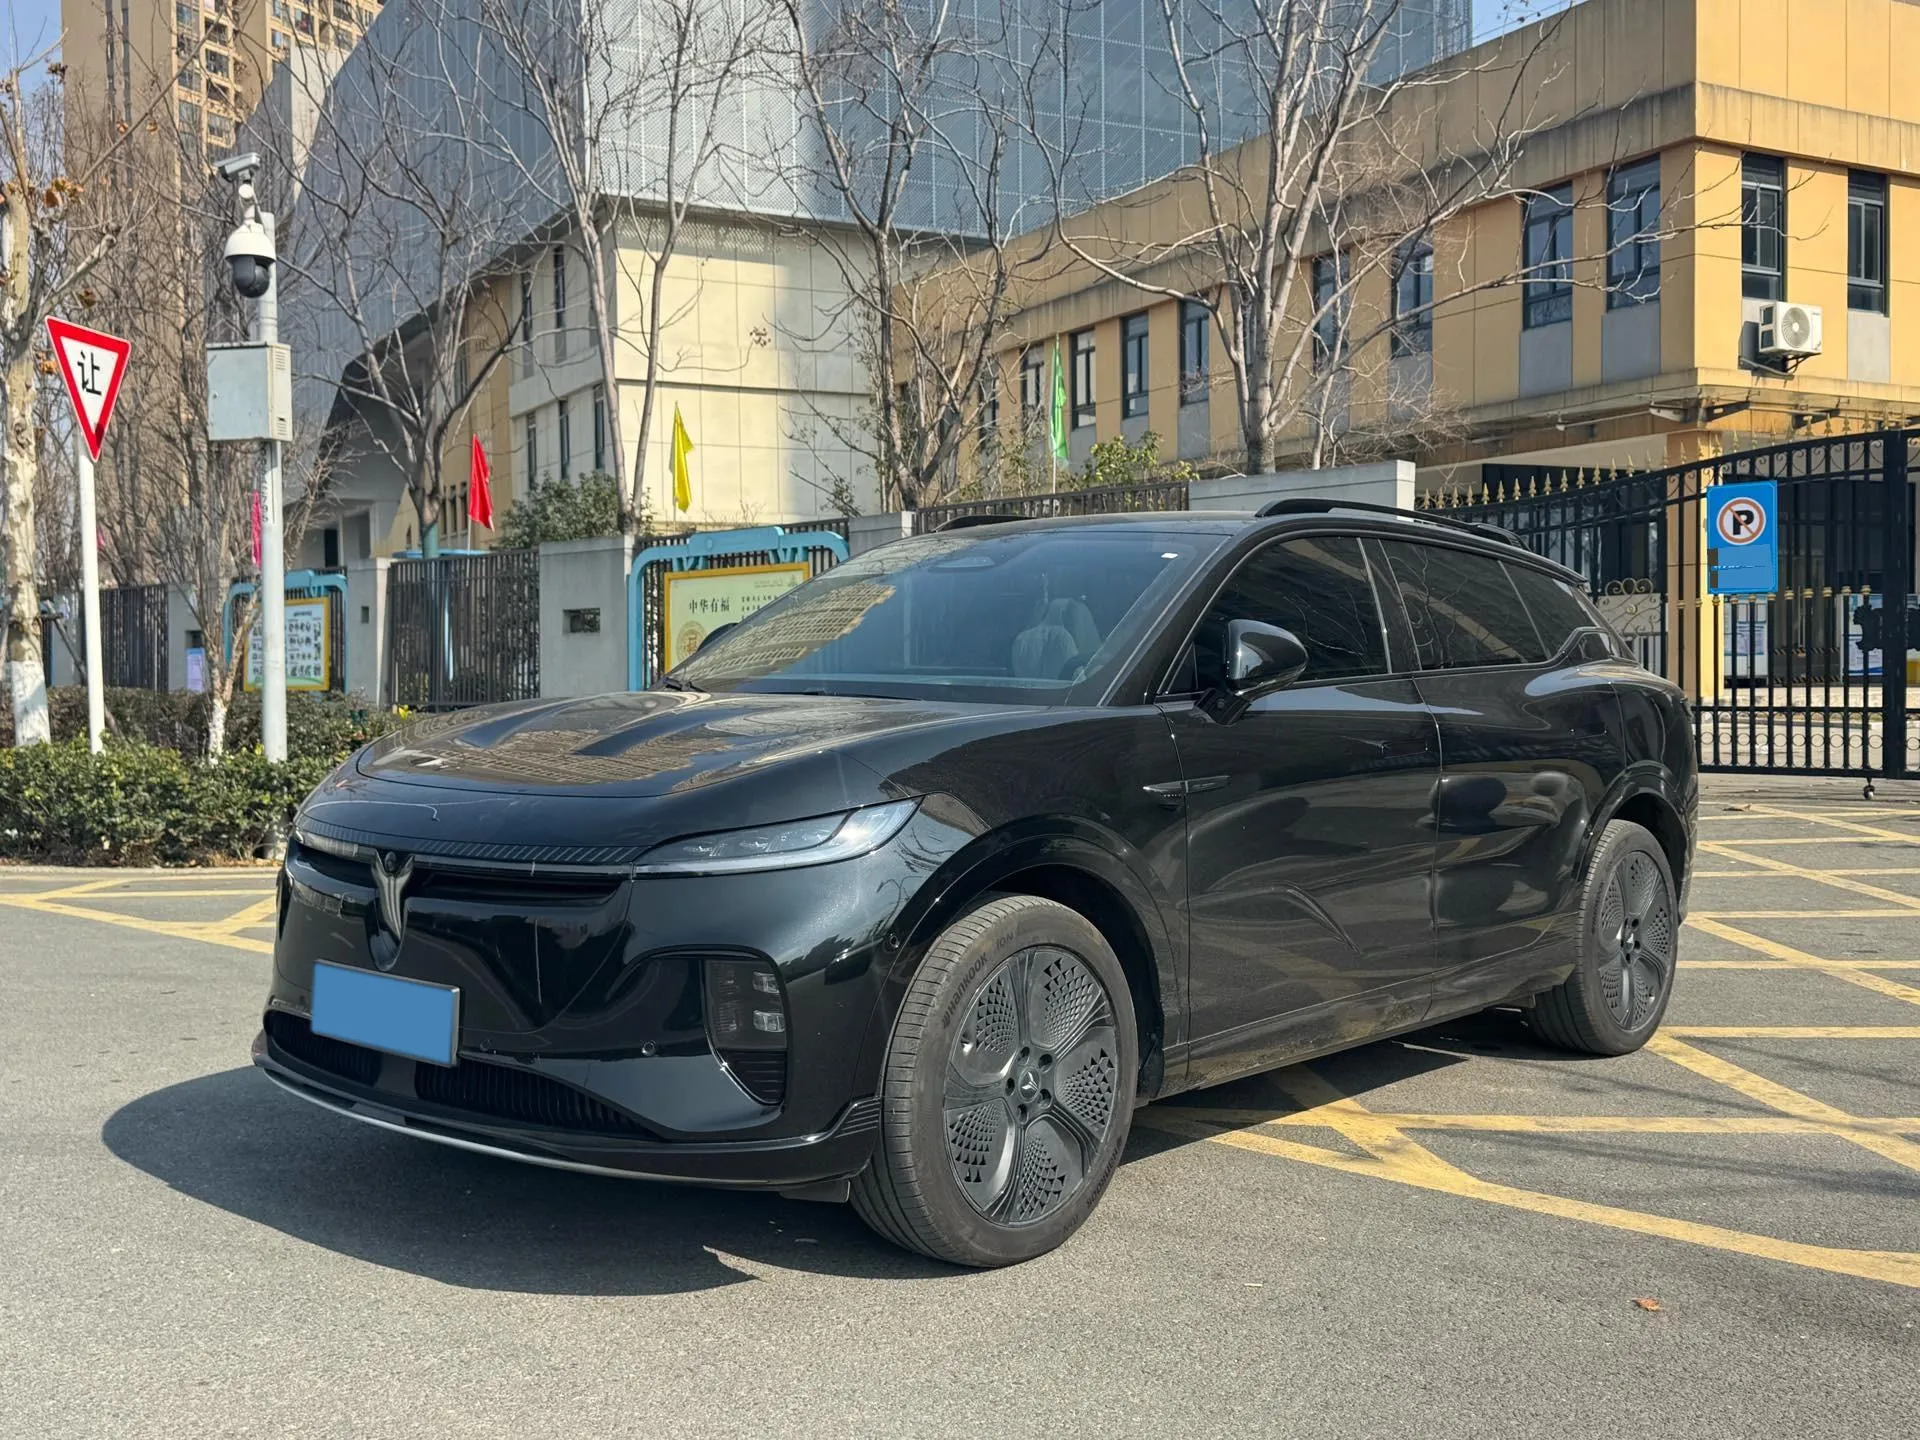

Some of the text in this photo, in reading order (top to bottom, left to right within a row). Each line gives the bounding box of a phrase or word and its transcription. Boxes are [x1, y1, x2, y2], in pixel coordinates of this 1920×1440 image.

[77, 350, 102, 396] 让
[1732, 509, 1755, 535] P
[689, 596, 730, 614] 中华有福
